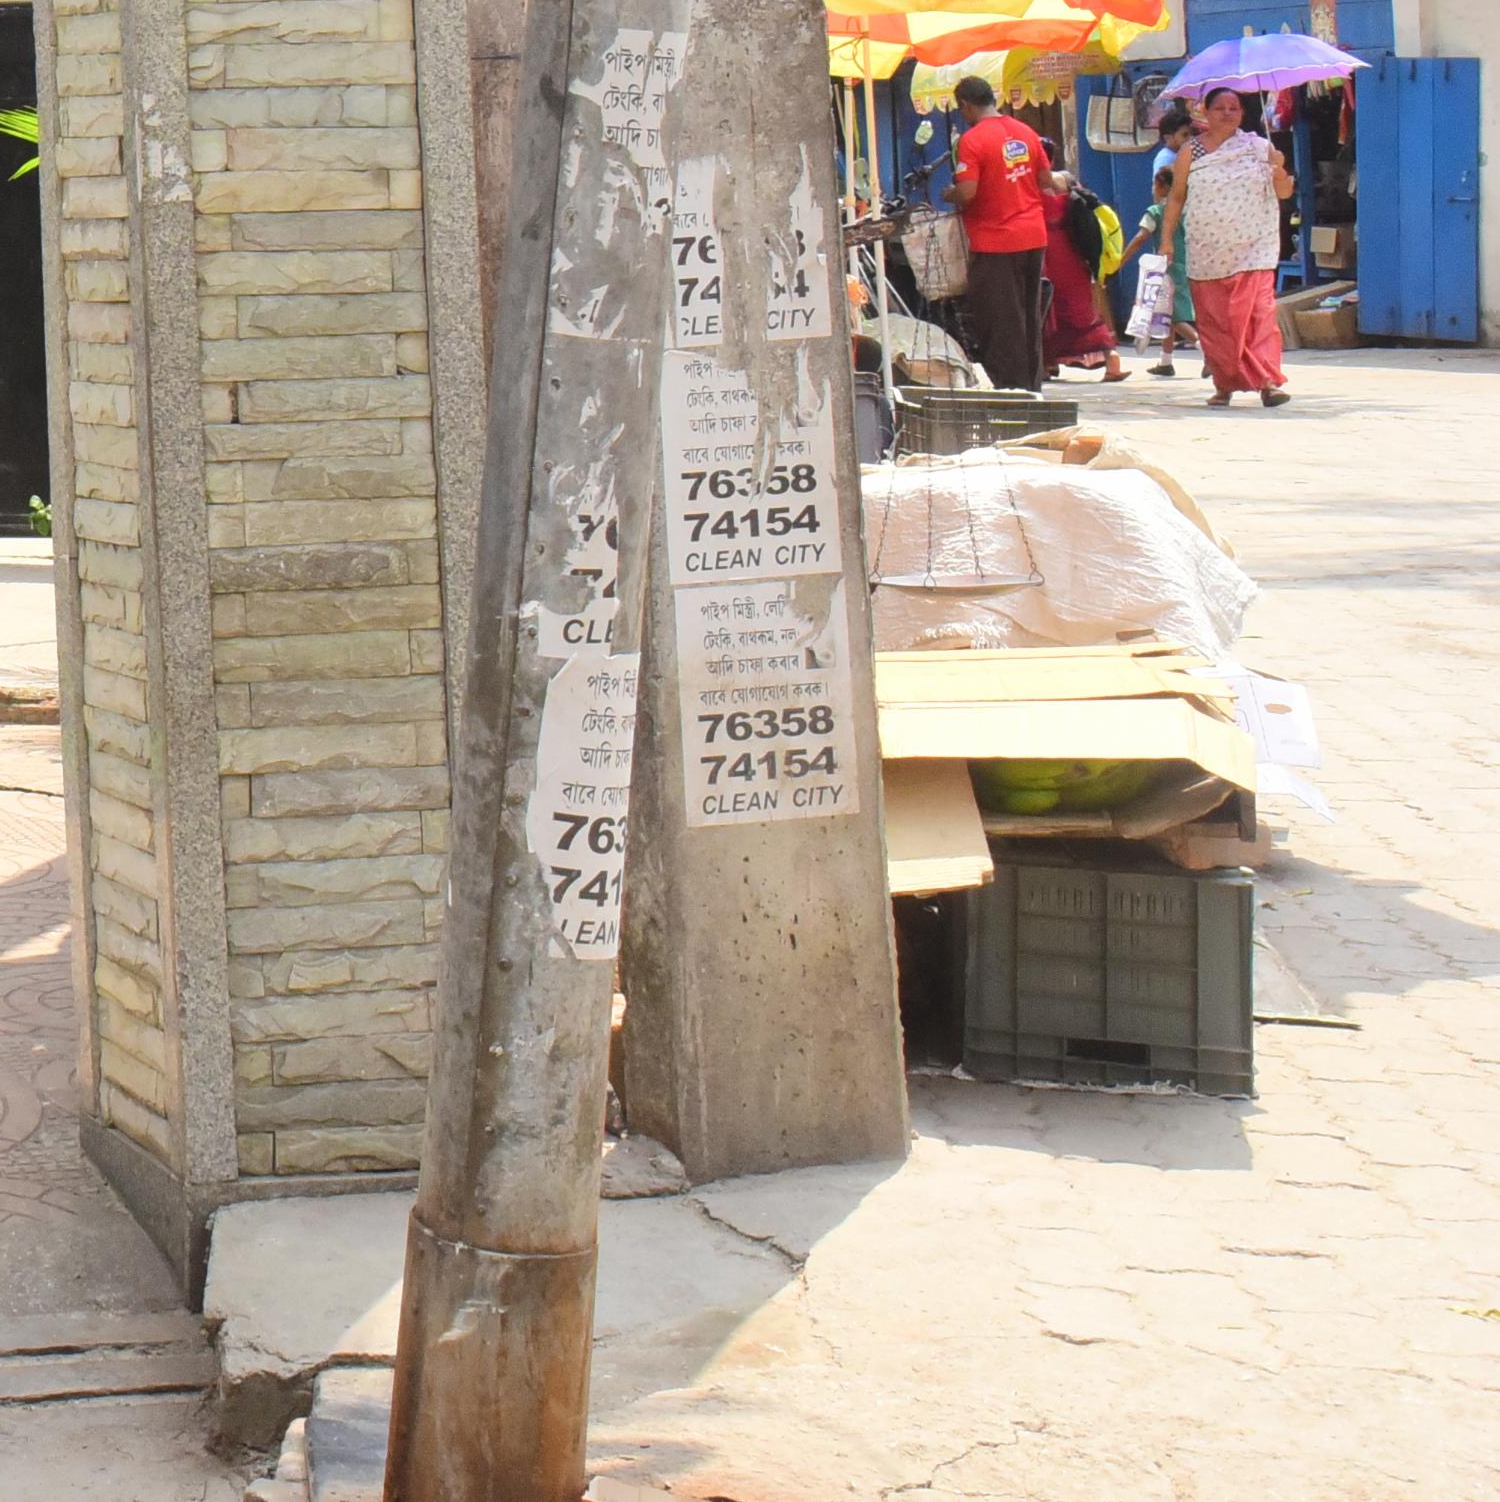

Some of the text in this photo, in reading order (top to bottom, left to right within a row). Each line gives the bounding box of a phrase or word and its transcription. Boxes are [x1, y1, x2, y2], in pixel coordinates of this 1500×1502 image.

[683, 504, 821, 543] 74154
[685, 542, 827, 572] CLEAN CITY
[697, 705, 835, 744] 76358
[700, 745, 838, 786] 74154
[702, 784, 844, 816] CLEAN CITY
